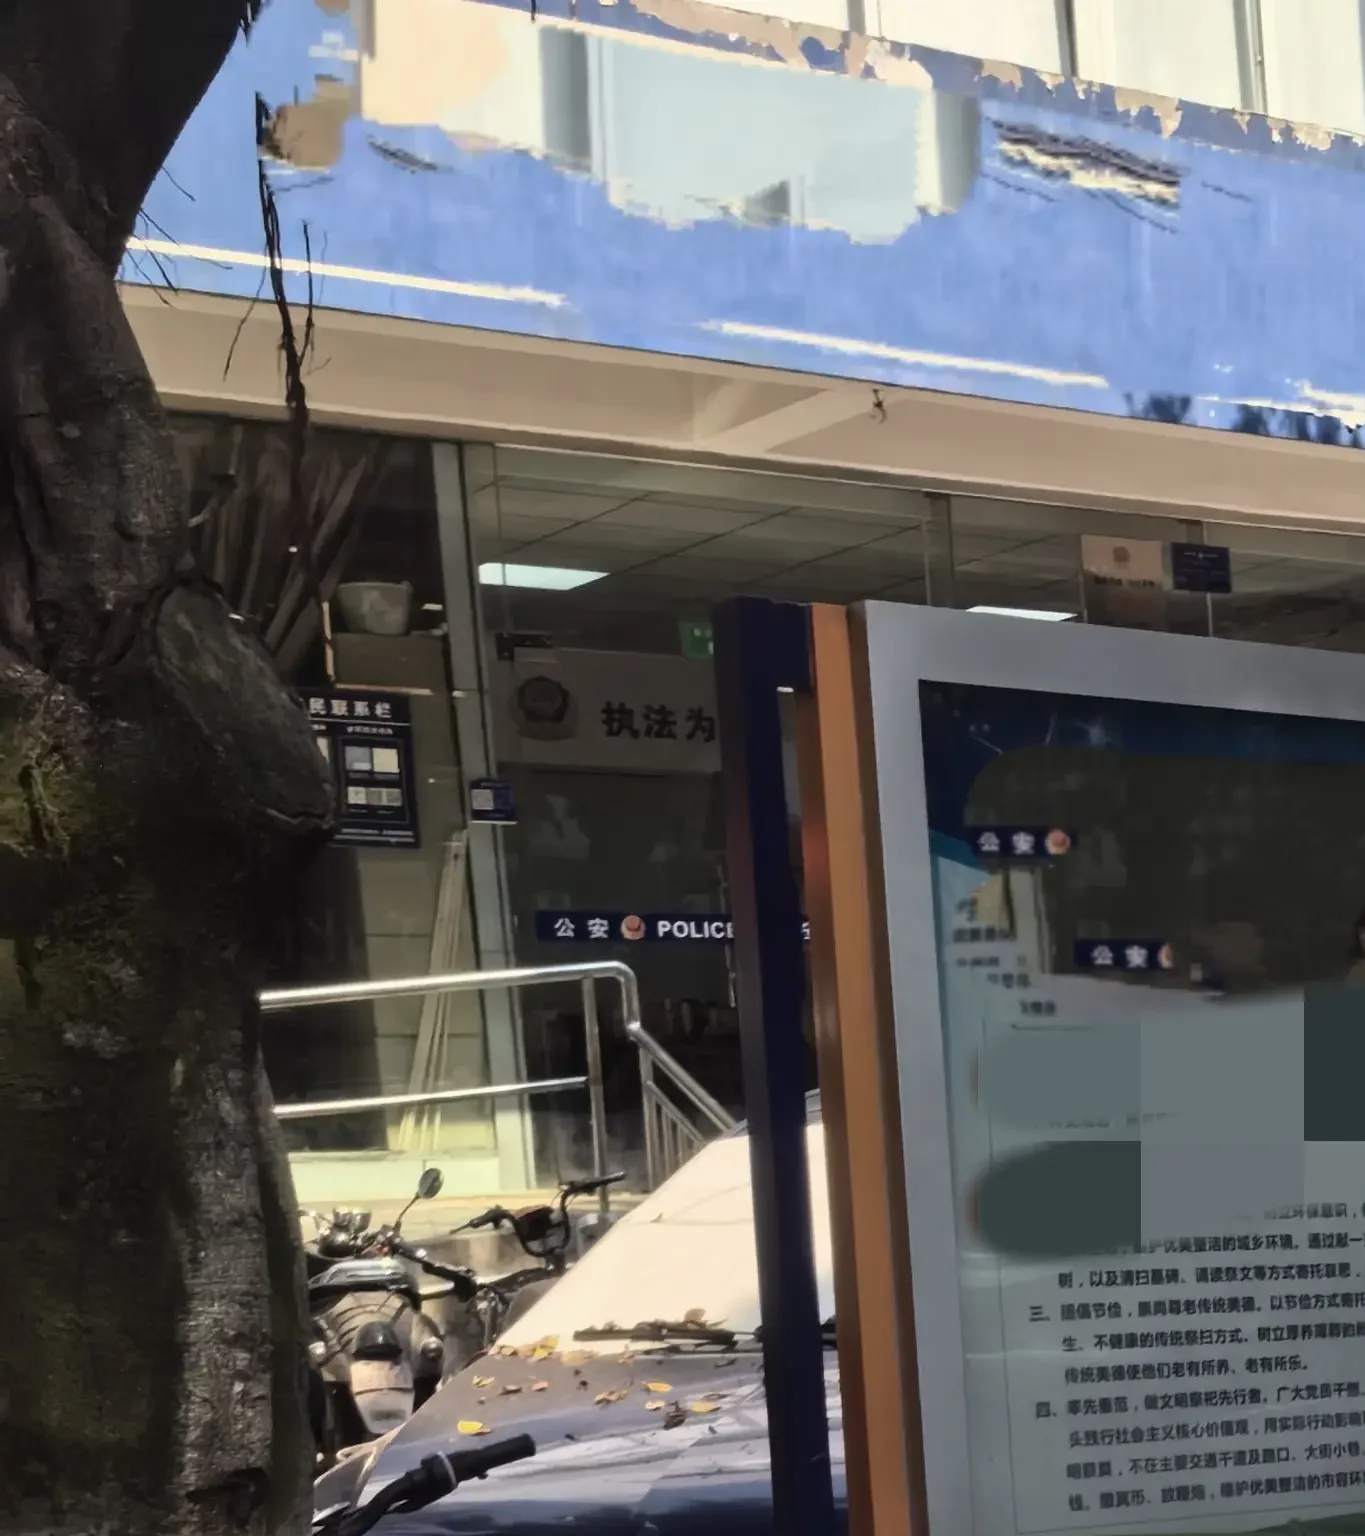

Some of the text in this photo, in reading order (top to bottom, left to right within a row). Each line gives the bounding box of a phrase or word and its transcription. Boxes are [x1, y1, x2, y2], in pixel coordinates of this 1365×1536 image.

[601, 700, 717, 744] 执法为
[554, 917, 610, 940] 公安
